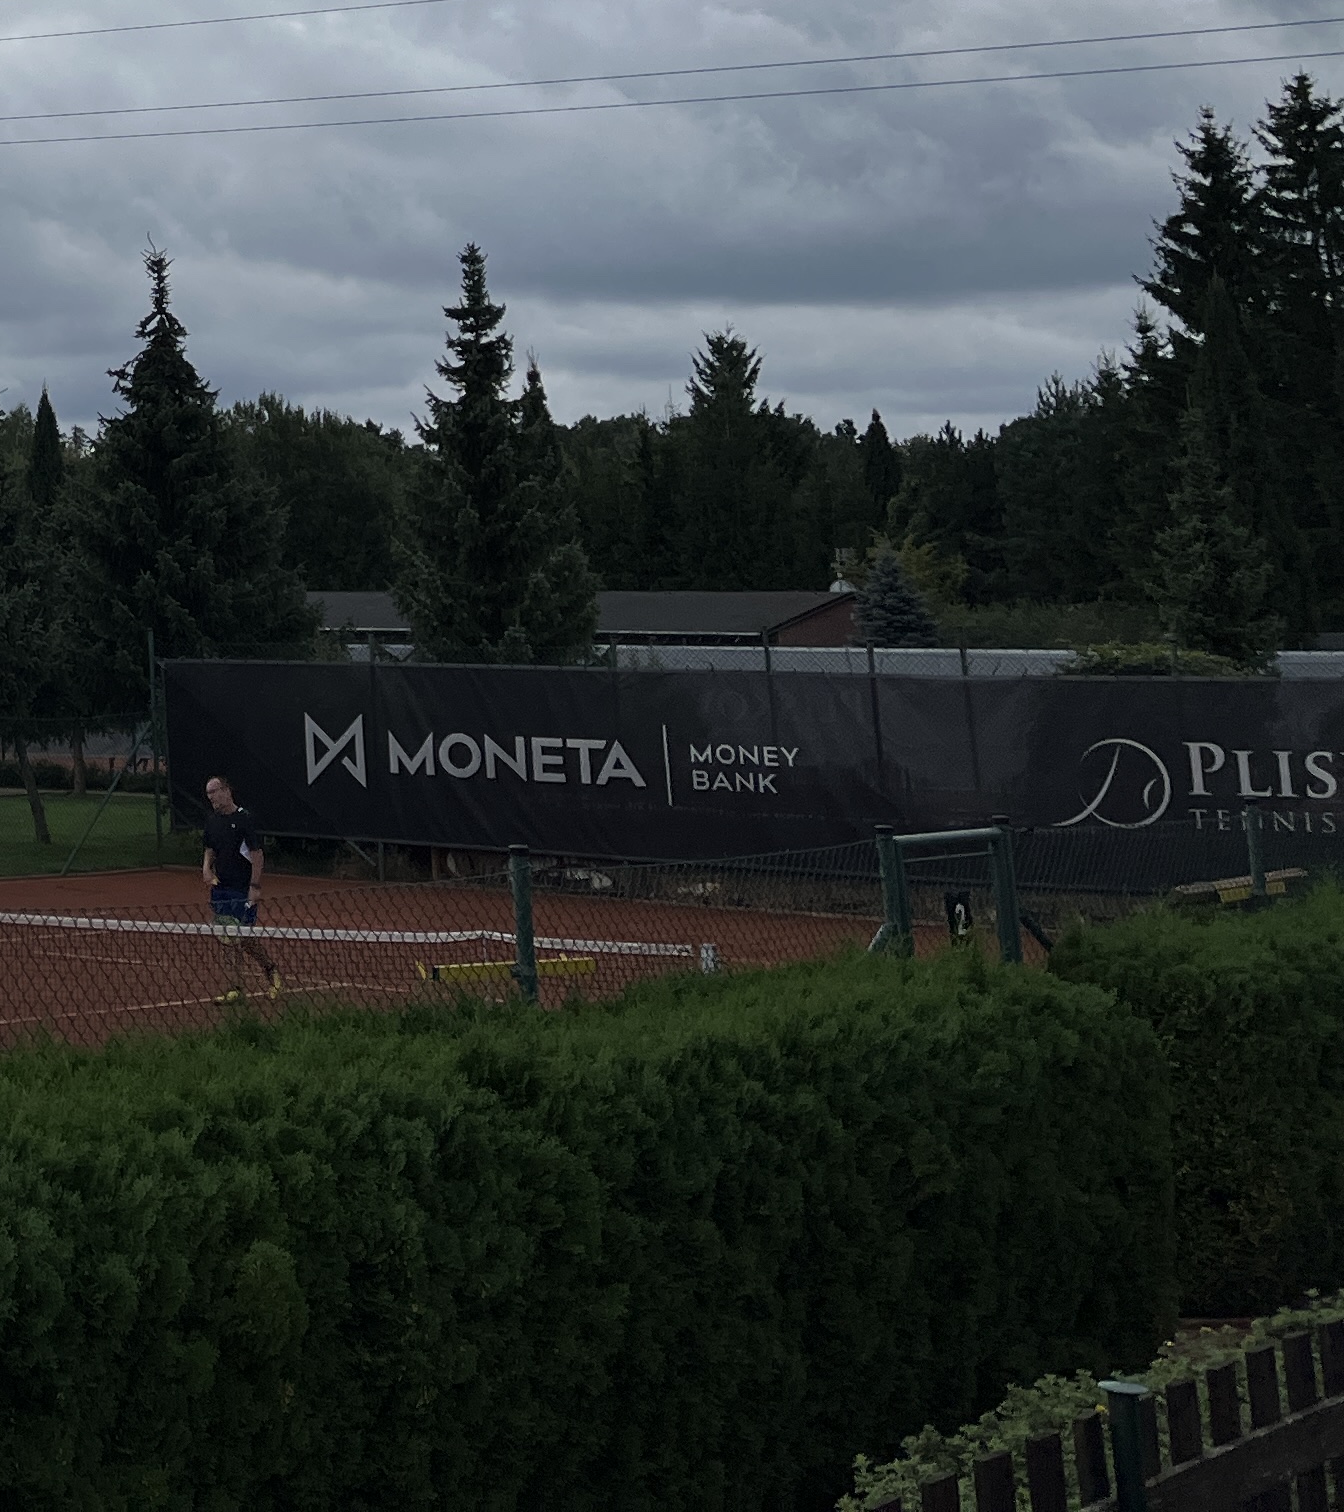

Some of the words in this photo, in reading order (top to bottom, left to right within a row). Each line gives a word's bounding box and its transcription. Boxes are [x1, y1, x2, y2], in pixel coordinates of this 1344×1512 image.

[388, 730, 646, 787] MONETA
[689, 744, 799, 768] MONEY
[1182, 741, 1344, 799] PLIS
[692, 769, 779, 794] BANK
